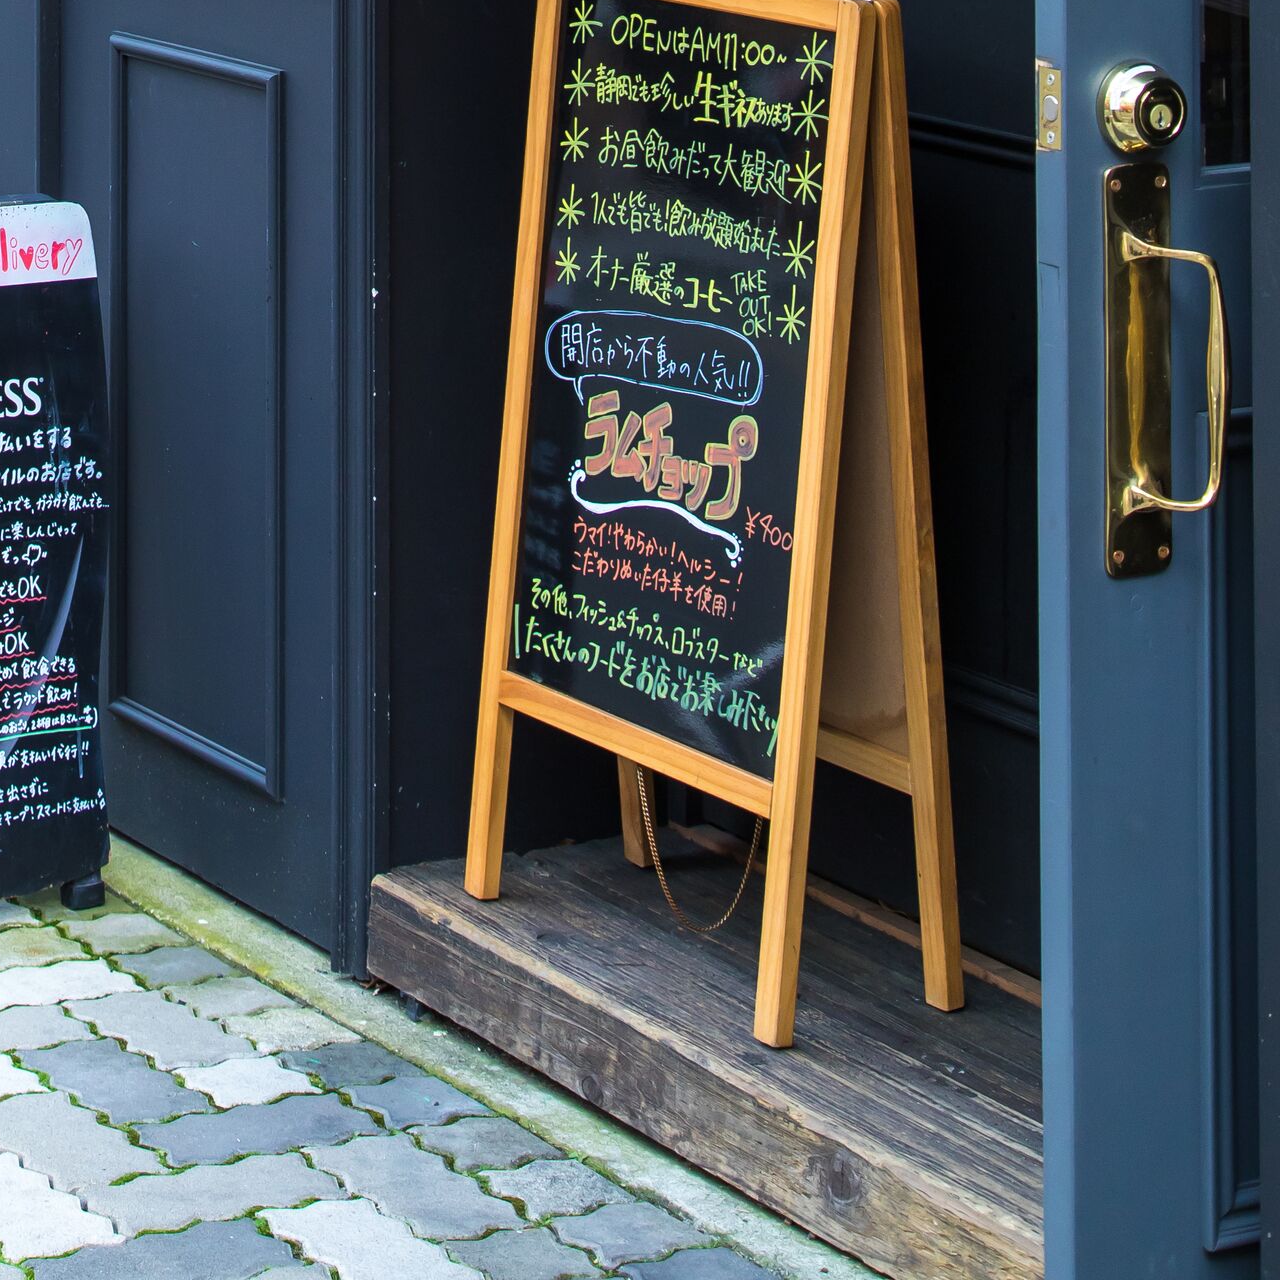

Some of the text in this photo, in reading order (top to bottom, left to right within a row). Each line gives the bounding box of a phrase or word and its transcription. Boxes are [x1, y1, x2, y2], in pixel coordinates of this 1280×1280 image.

[730, 269, 767, 296] TAKE
[739, 295, 771, 318] OUT
[742, 311, 772, 339] OK!
[561, 323, 751, 399] 開店から不動の人気!!
[584, 389, 759, 521] ラムチョップ
[745, 505, 793, 552] ¥400
